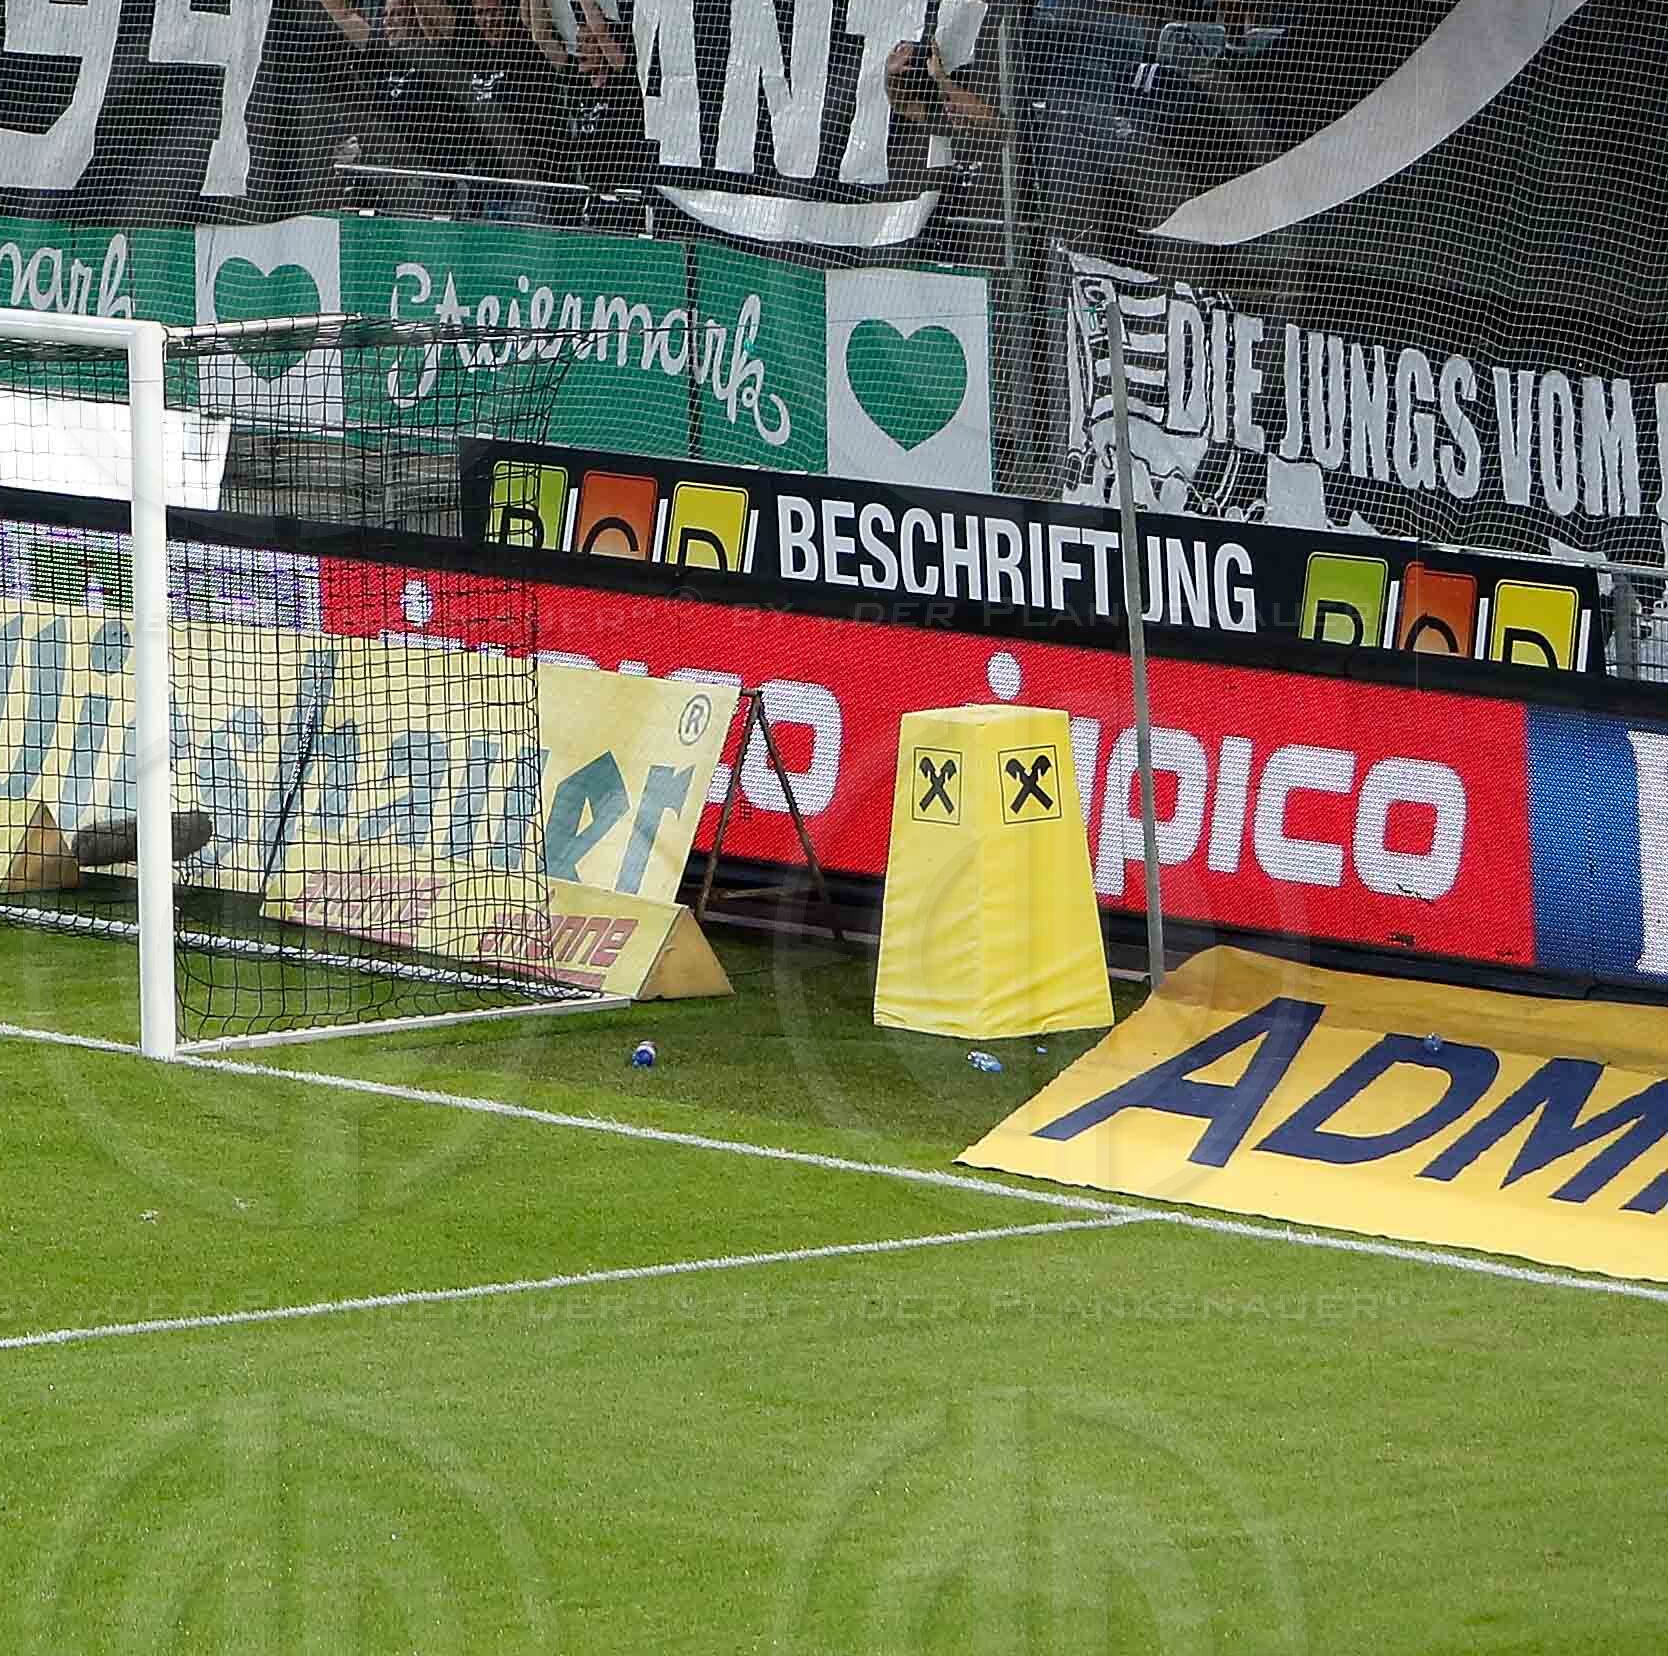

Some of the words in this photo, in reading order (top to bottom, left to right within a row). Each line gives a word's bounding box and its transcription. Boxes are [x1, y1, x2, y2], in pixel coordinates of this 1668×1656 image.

[389, 261, 791, 447] Steiermark
[1168, 297, 1266, 454] DIE
[1278, 323, 1482, 500] JUNGS
[1493, 366, 1643, 518] VOM
[776, 494, 1258, 635] BESCHRIFTUNG
[1033, 997, 1668, 1216] ADM
